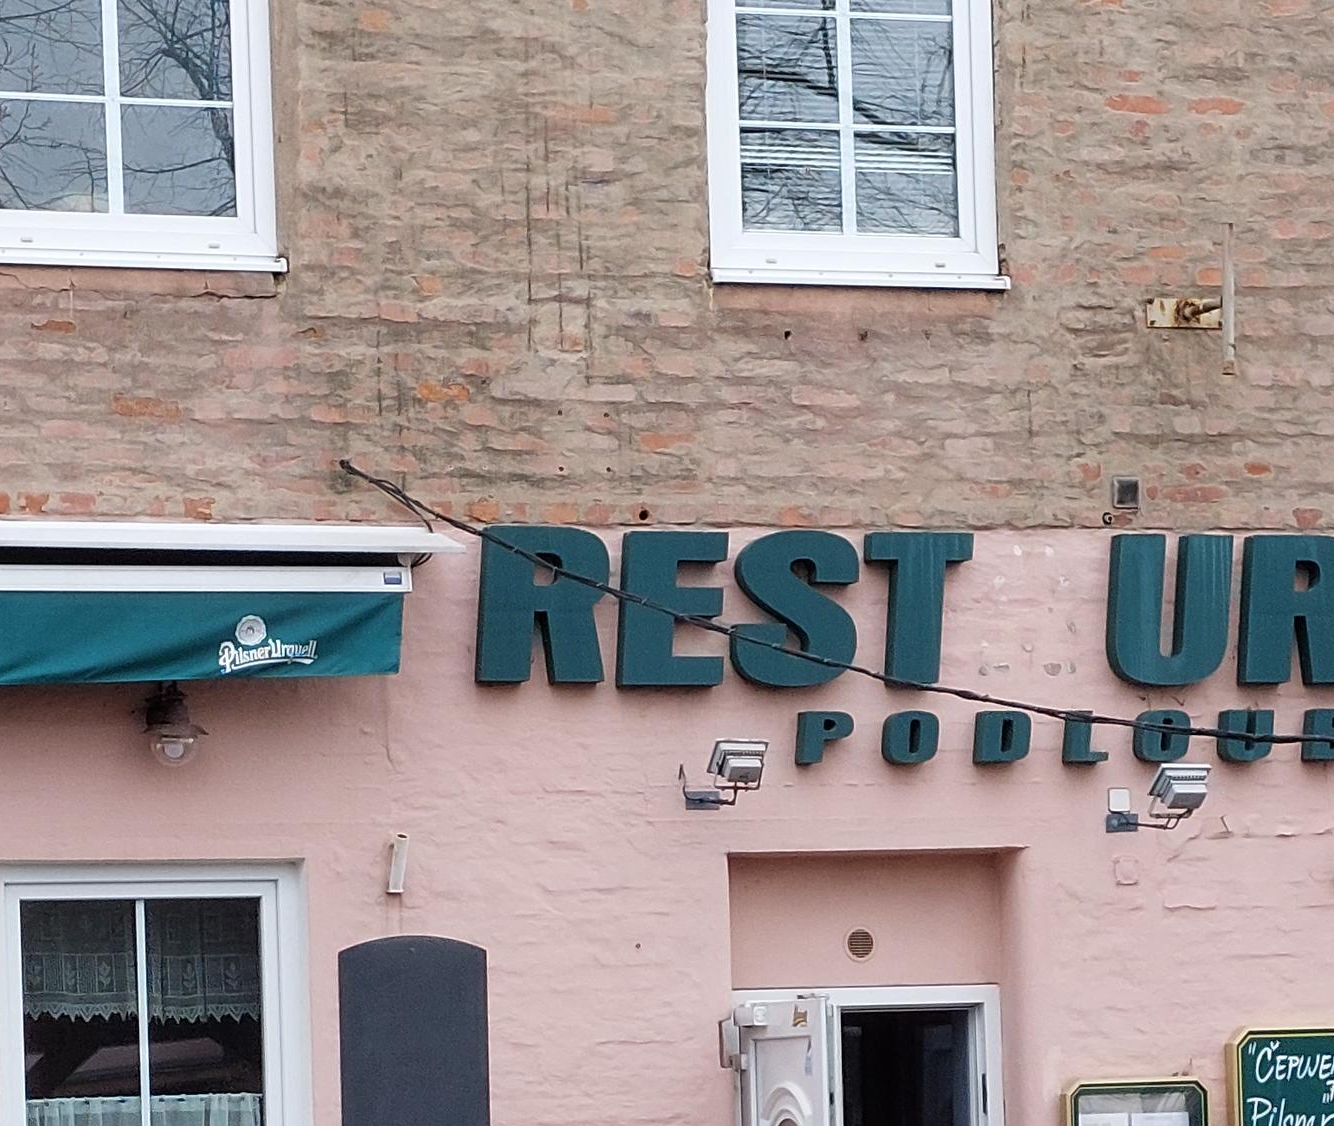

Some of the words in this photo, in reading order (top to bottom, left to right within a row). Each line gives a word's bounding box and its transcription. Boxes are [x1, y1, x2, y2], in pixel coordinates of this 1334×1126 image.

[219, 641, 270, 674] Pilsner
[269, 638, 318, 664] Urquell
[475, 523, 975, 691] REST
